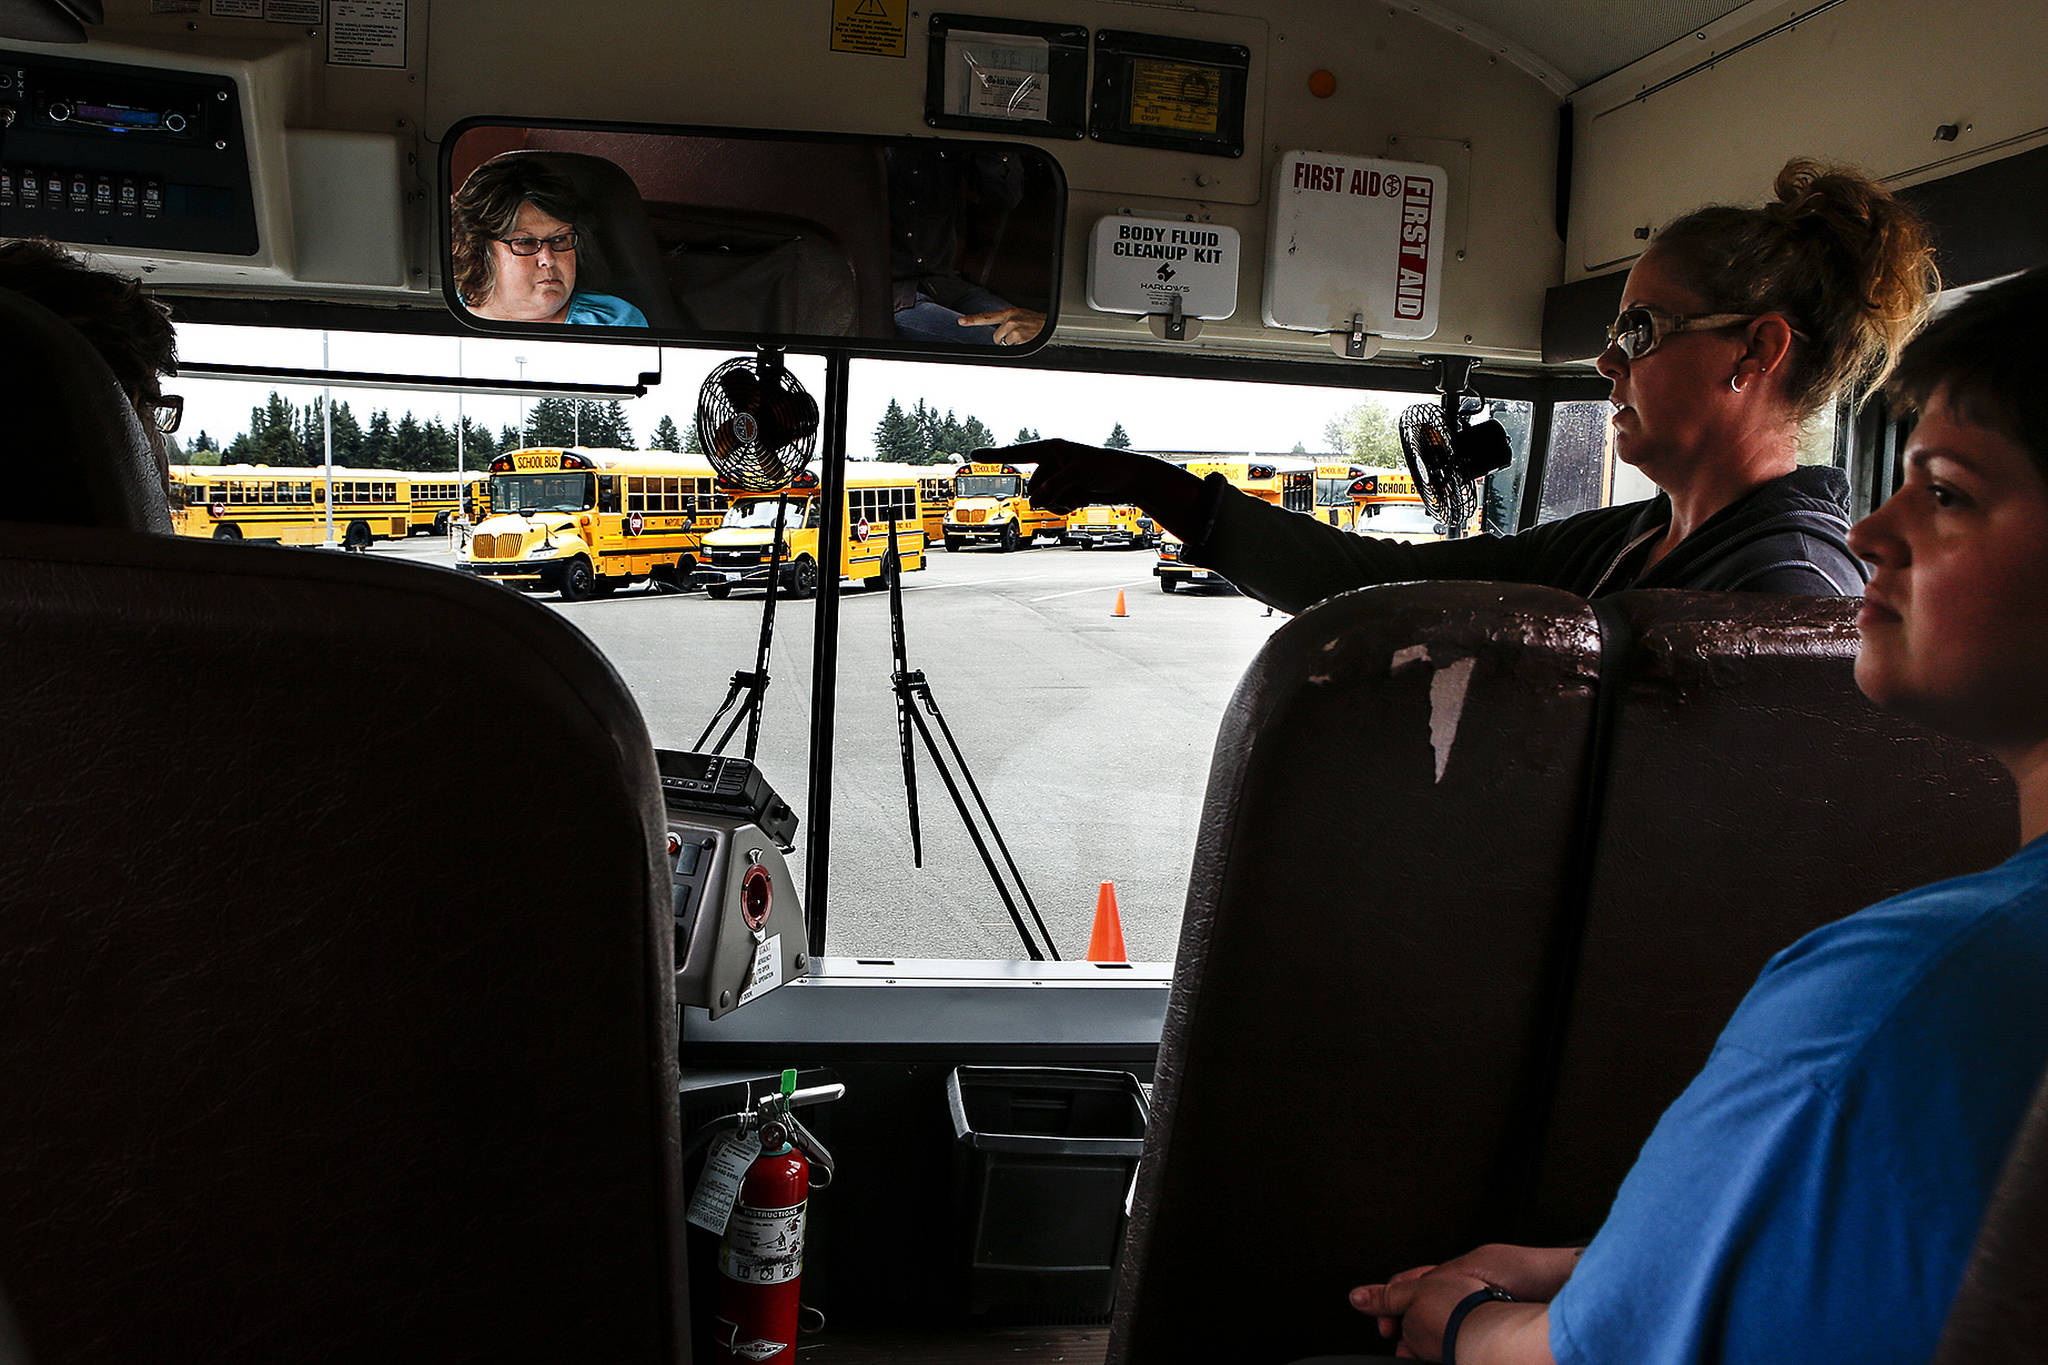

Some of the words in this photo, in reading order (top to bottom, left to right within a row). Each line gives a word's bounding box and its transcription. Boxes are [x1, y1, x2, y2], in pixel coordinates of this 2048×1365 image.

[17, 70, 25, 98] EXT
[1293, 162, 1345, 193] FIRST
[1350, 169, 1382, 197] AID
[1401, 180, 1431, 260] FIRST
[1119, 225, 1166, 243] BODY
[1171, 230, 1219, 247] FLUID
[1113, 241, 1187, 261] CLEANUP
[1194, 248, 1223, 264] KIT
[1397, 267, 1424, 316] AID
[518, 455, 543, 469] SCHOOL
[545, 455, 558, 468] BUS
[973, 465, 990, 474] SCHOOL
[990, 465, 1000, 473] BUS
[1378, 482, 1408, 494] SCHOOL
[632, 519, 641, 528] STOP
[744, 1209, 798, 1218] INSTRUCTIONS
